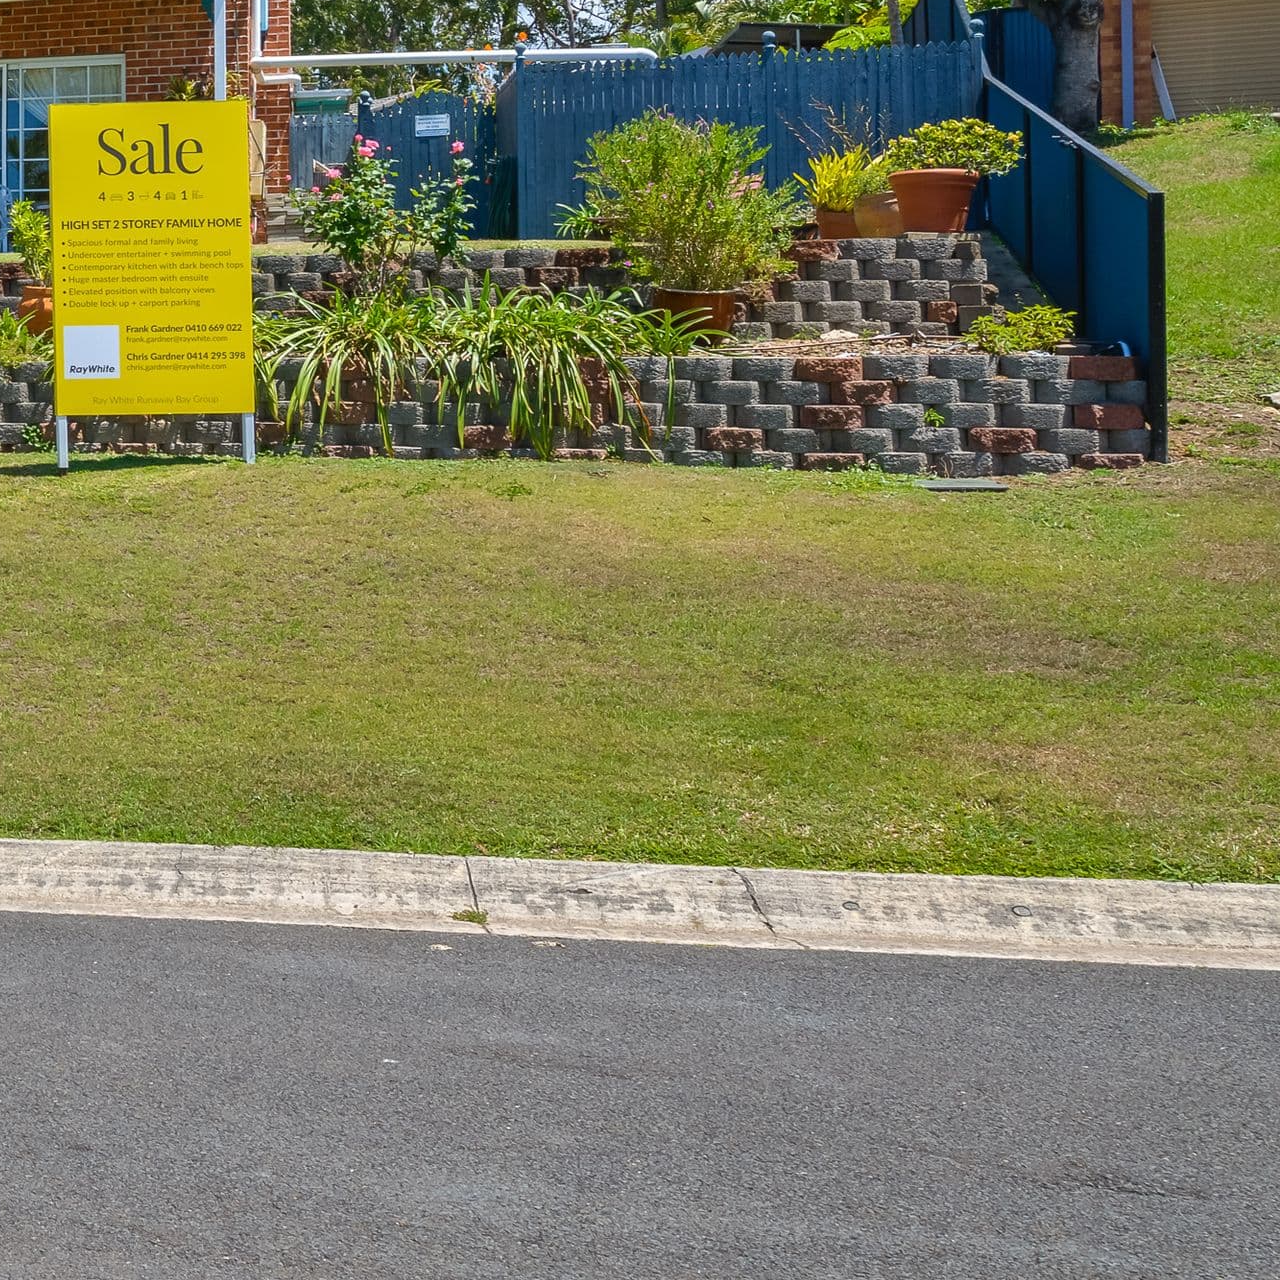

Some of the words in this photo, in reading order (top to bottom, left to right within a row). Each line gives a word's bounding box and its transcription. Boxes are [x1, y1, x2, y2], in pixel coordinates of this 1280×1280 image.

[97, 123, 204, 176] Sale
[98, 192, 106, 201] 4
[127, 191, 135, 201] 3
[153, 190, 161, 200] 4
[181, 190, 188, 200] 1
[61, 220, 90, 230] HIGH
[92, 220, 111, 230] SET
[113, 220, 120, 229] 2
[122, 219, 164, 229] STOREY
[166, 218, 206, 228] FAMILY
[207, 217, 242, 227] HOME
[67, 239, 103, 248] Spacious
[105, 238, 131, 246] formal
[132, 238, 148, 246] and
[150, 237, 174, 246] family
[176, 237, 199, 246] living
[68, 251, 114, 259] Undercover
[116, 249, 161, 258] entertainer
[171, 249, 211, 258] swimming
[213, 248, 232, 257] pool
[68, 263, 125, 272] Contemporary
[127, 262, 158, 270] kitchen
[160, 262, 178, 270] with
[179, 262, 197, 270] dark
[199, 261, 224, 270] bench
[226, 261, 244, 270] tops
[68, 276, 90, 285] Huge
[121, 274, 158, 283] bedroom
[160, 274, 178, 282] with
[180, 274, 209, 282] ensuite
[68, 287, 104, 296] Elevated
[105, 287, 138, 296] position
[140, 287, 158, 295] with
[160, 286, 191, 296] balcony
[69, 300, 98, 308] Double
[100, 299, 117, 308] lock
[119, 300, 130, 309] up
[139, 299, 169, 308] carport
[170, 298, 201, 308] parking
[126, 325, 149, 333] Frank
[150, 324, 184, 332] Gardner
[185, 324, 207, 332] 0410
[208, 323, 224, 332] 669
[226, 323, 243, 332] 022
[126, 353, 149, 361] Chris
[150, 352, 185, 361] Gardner
[186, 352, 209, 360] 0414
[210, 351, 227, 360] 295
[229, 351, 246, 360] 398
[69, 365, 116, 375] RayWhite
[92, 396, 109, 405] Ray
[109, 396, 135, 404] White
[136, 395, 174, 405] Runaway
[175, 394, 192, 404] Bay
[193, 394, 220, 404] Group
